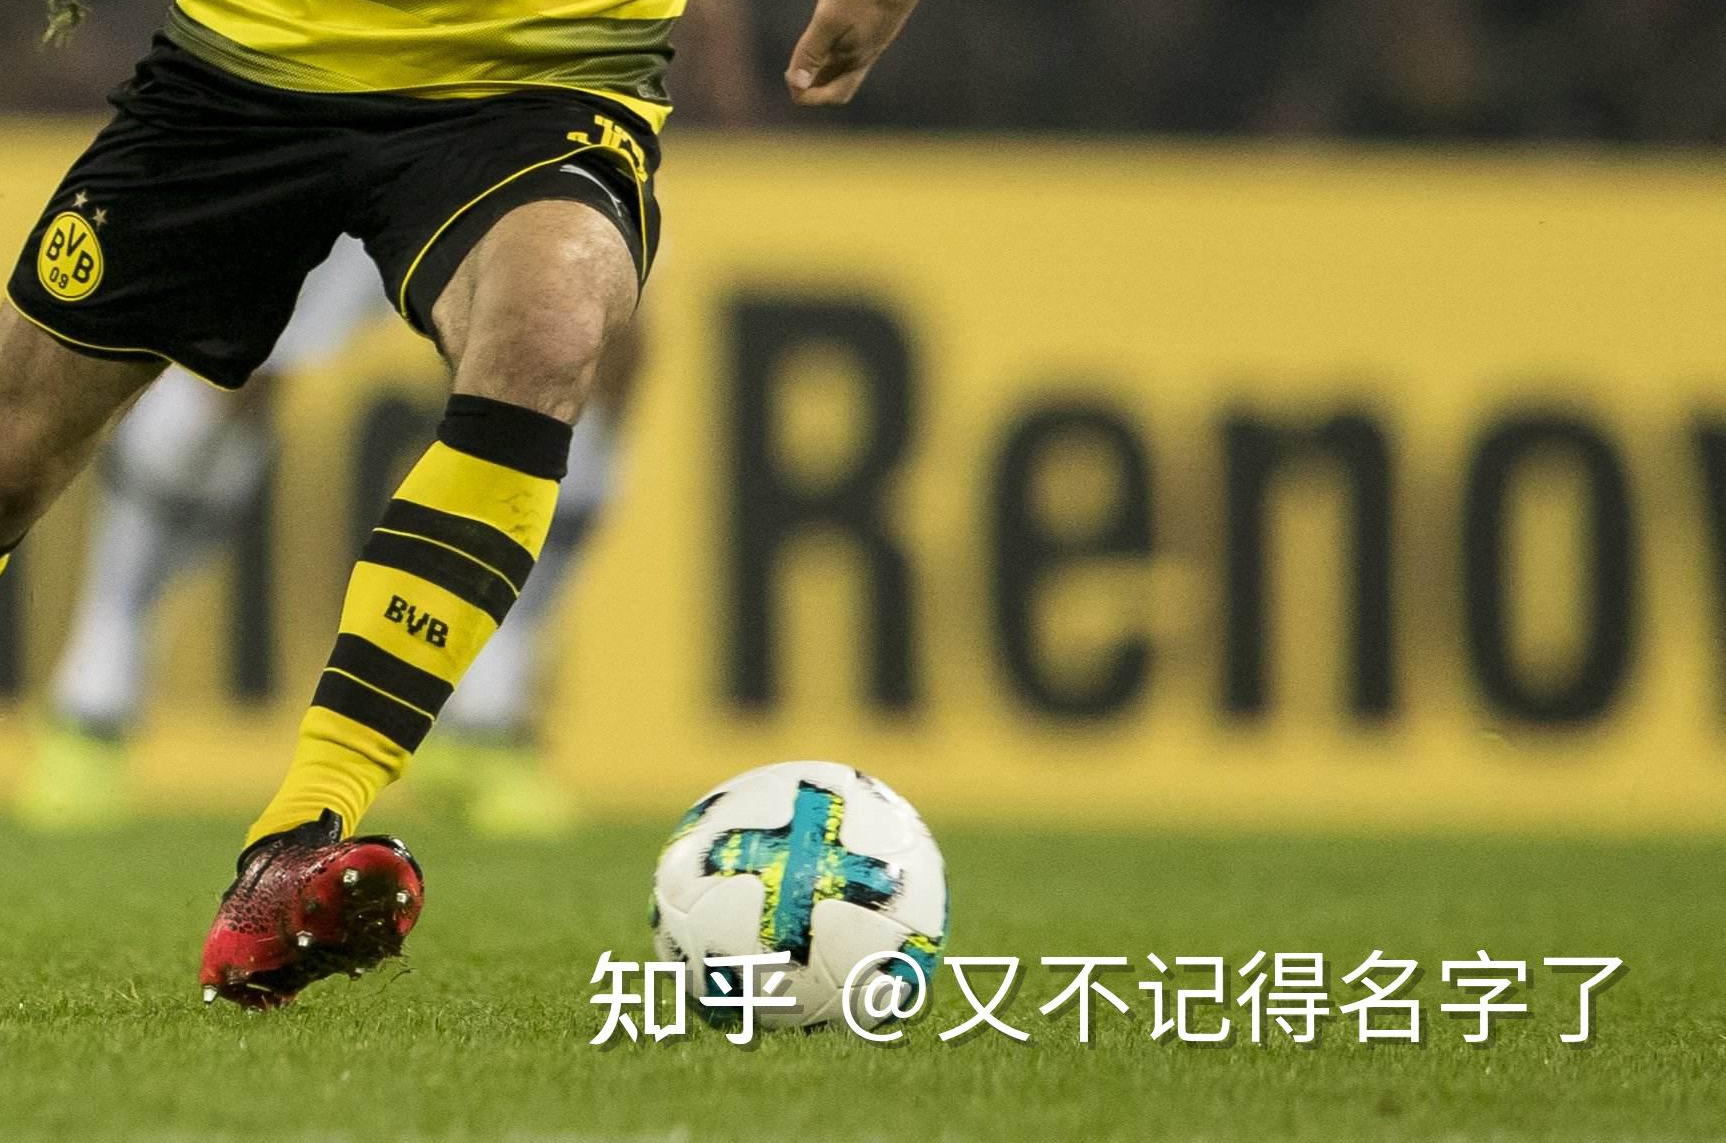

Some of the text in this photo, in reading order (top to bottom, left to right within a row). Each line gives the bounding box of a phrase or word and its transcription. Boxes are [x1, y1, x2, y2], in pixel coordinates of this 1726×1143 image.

[46, 222, 94, 284] BVB
[49, 266, 69, 289] 09
[721, 291, 1726, 724] Reno
[384, 594, 449, 648] BVB
